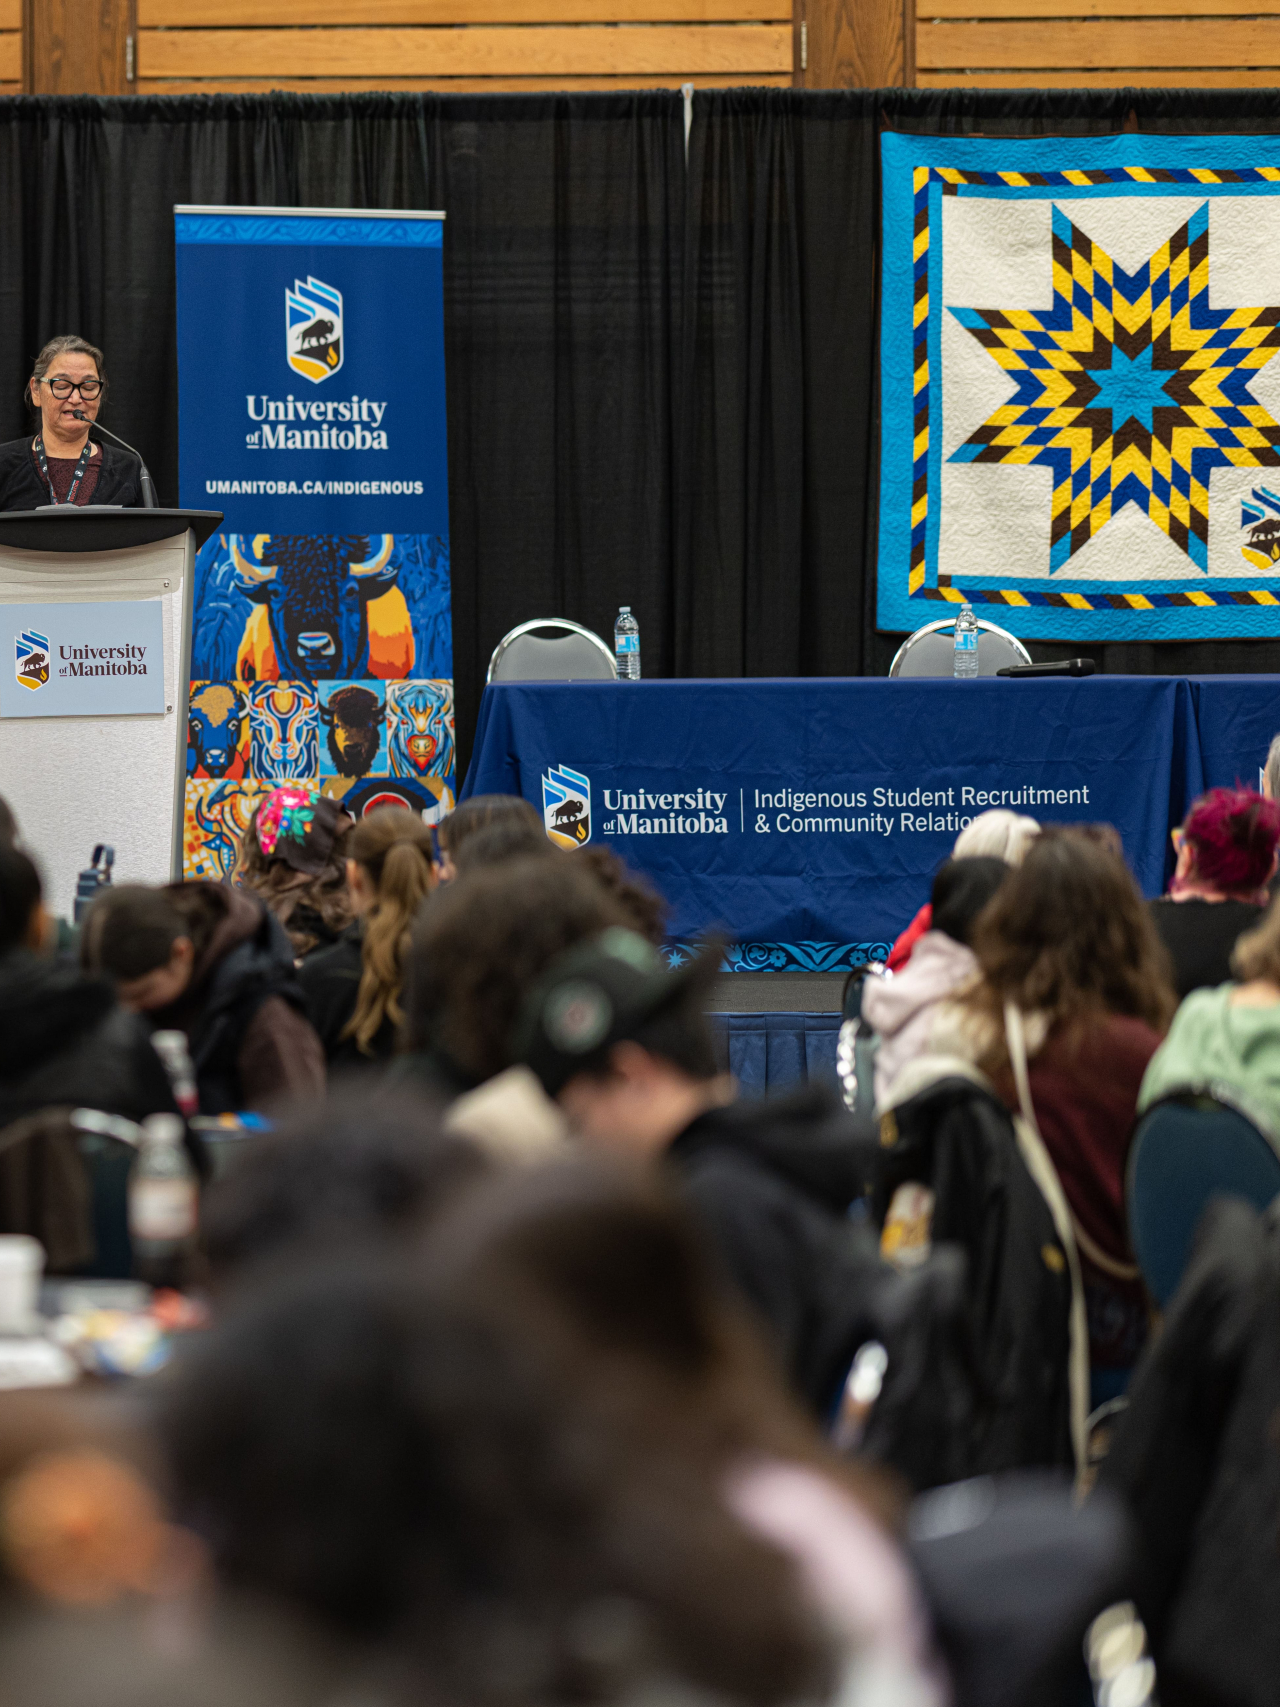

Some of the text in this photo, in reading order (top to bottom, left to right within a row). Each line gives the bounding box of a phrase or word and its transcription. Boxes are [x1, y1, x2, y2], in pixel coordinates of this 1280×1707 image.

[246, 395, 387, 427] University
[246, 424, 389, 450] of Manitoba
[205, 480, 424, 495] UMANITOBA.CA/INDIGENOUS
[58, 643, 147, 662] University
[58, 660, 148, 677] of Manitoba
[603, 788, 728, 814] University
[754, 785, 1090, 811] Indigenous Student Recruitment
[603, 812, 729, 835] of Manitoba
[754, 813, 771, 833] &
[776, 812, 895, 836] Community
